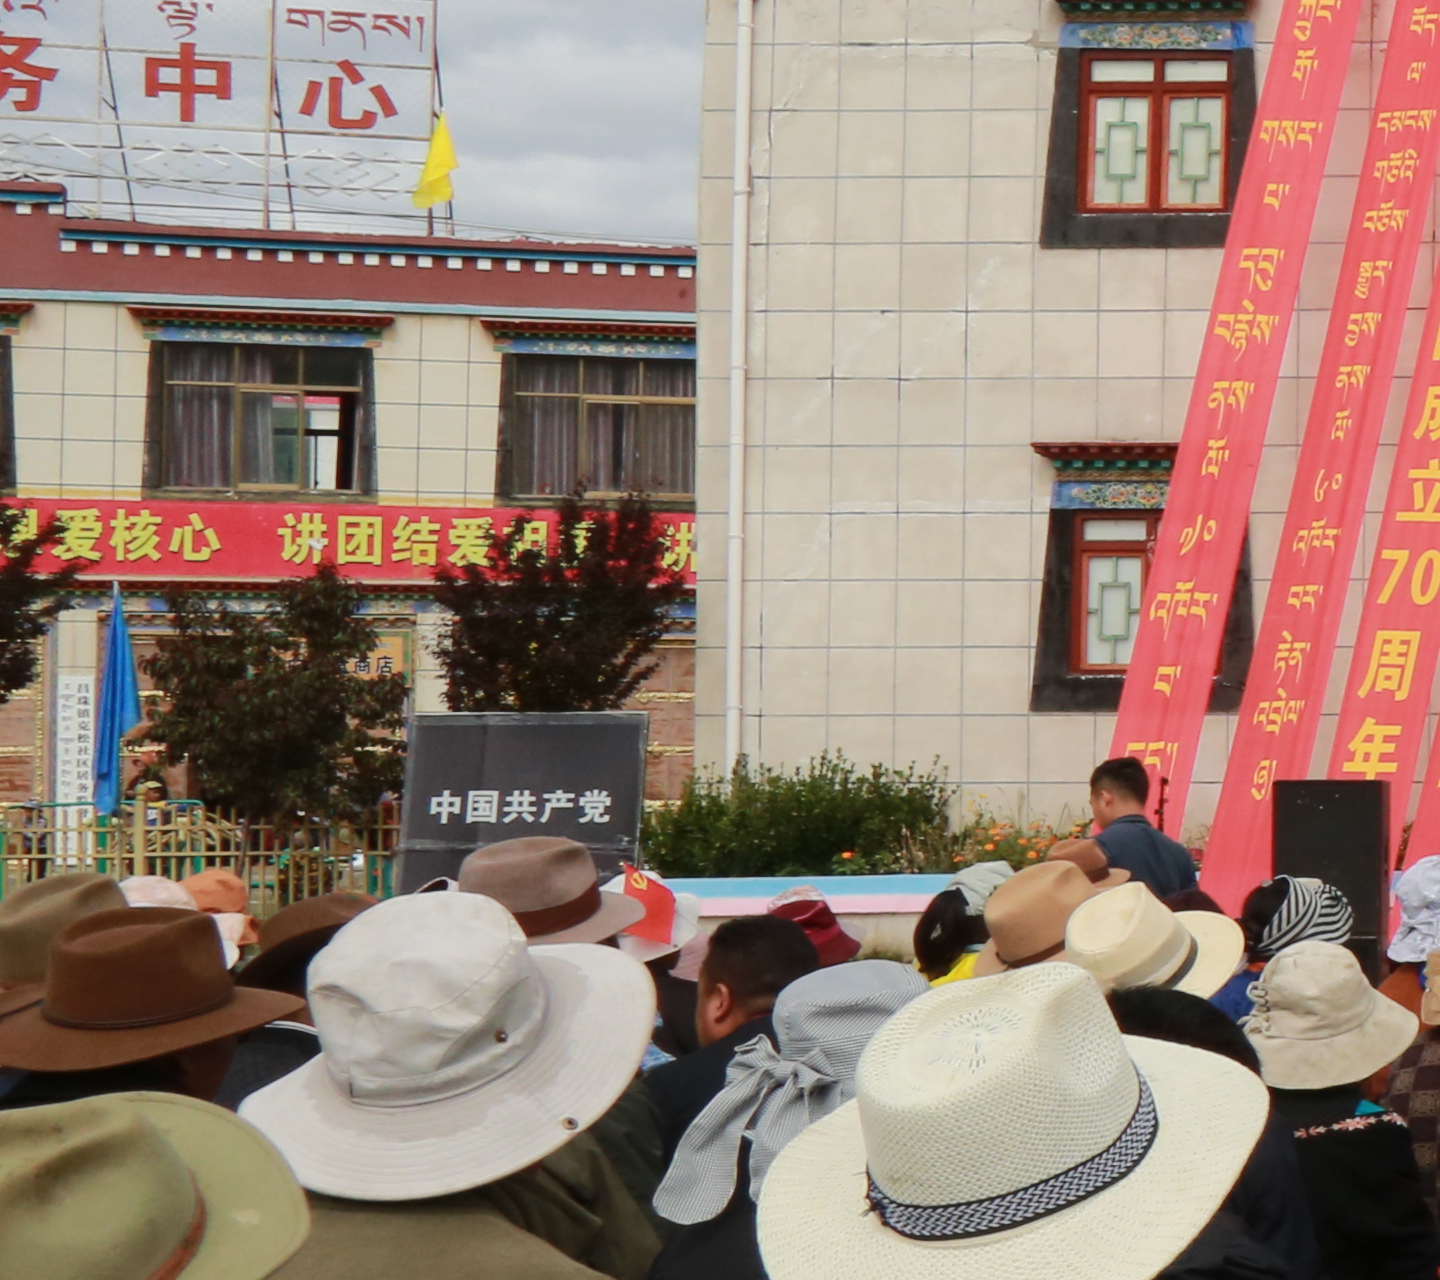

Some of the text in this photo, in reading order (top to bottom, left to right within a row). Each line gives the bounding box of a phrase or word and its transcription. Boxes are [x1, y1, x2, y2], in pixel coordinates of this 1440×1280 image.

[428, 788, 613, 825] 中国共产党
